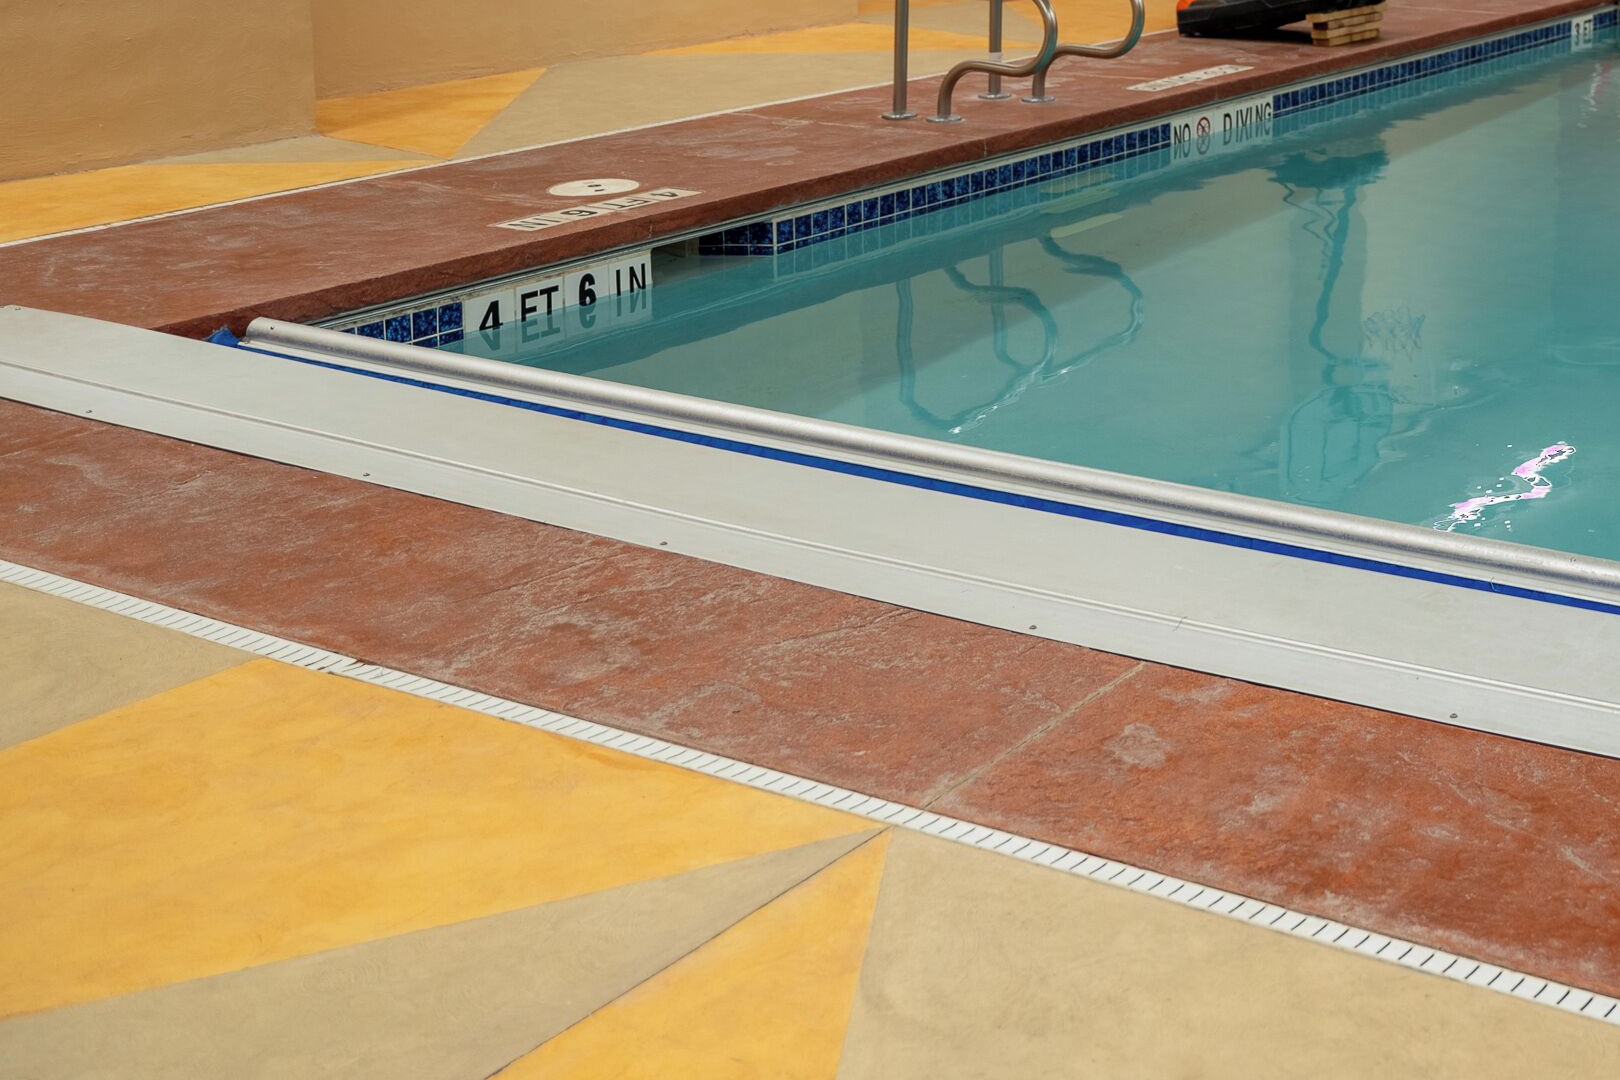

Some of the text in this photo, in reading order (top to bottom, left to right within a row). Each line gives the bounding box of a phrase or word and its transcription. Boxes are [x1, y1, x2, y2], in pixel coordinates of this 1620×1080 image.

[1173, 123, 1191, 145] NO
[508, 217, 561, 229] IN
[479, 263, 647, 332] 4 FT 6 IN
